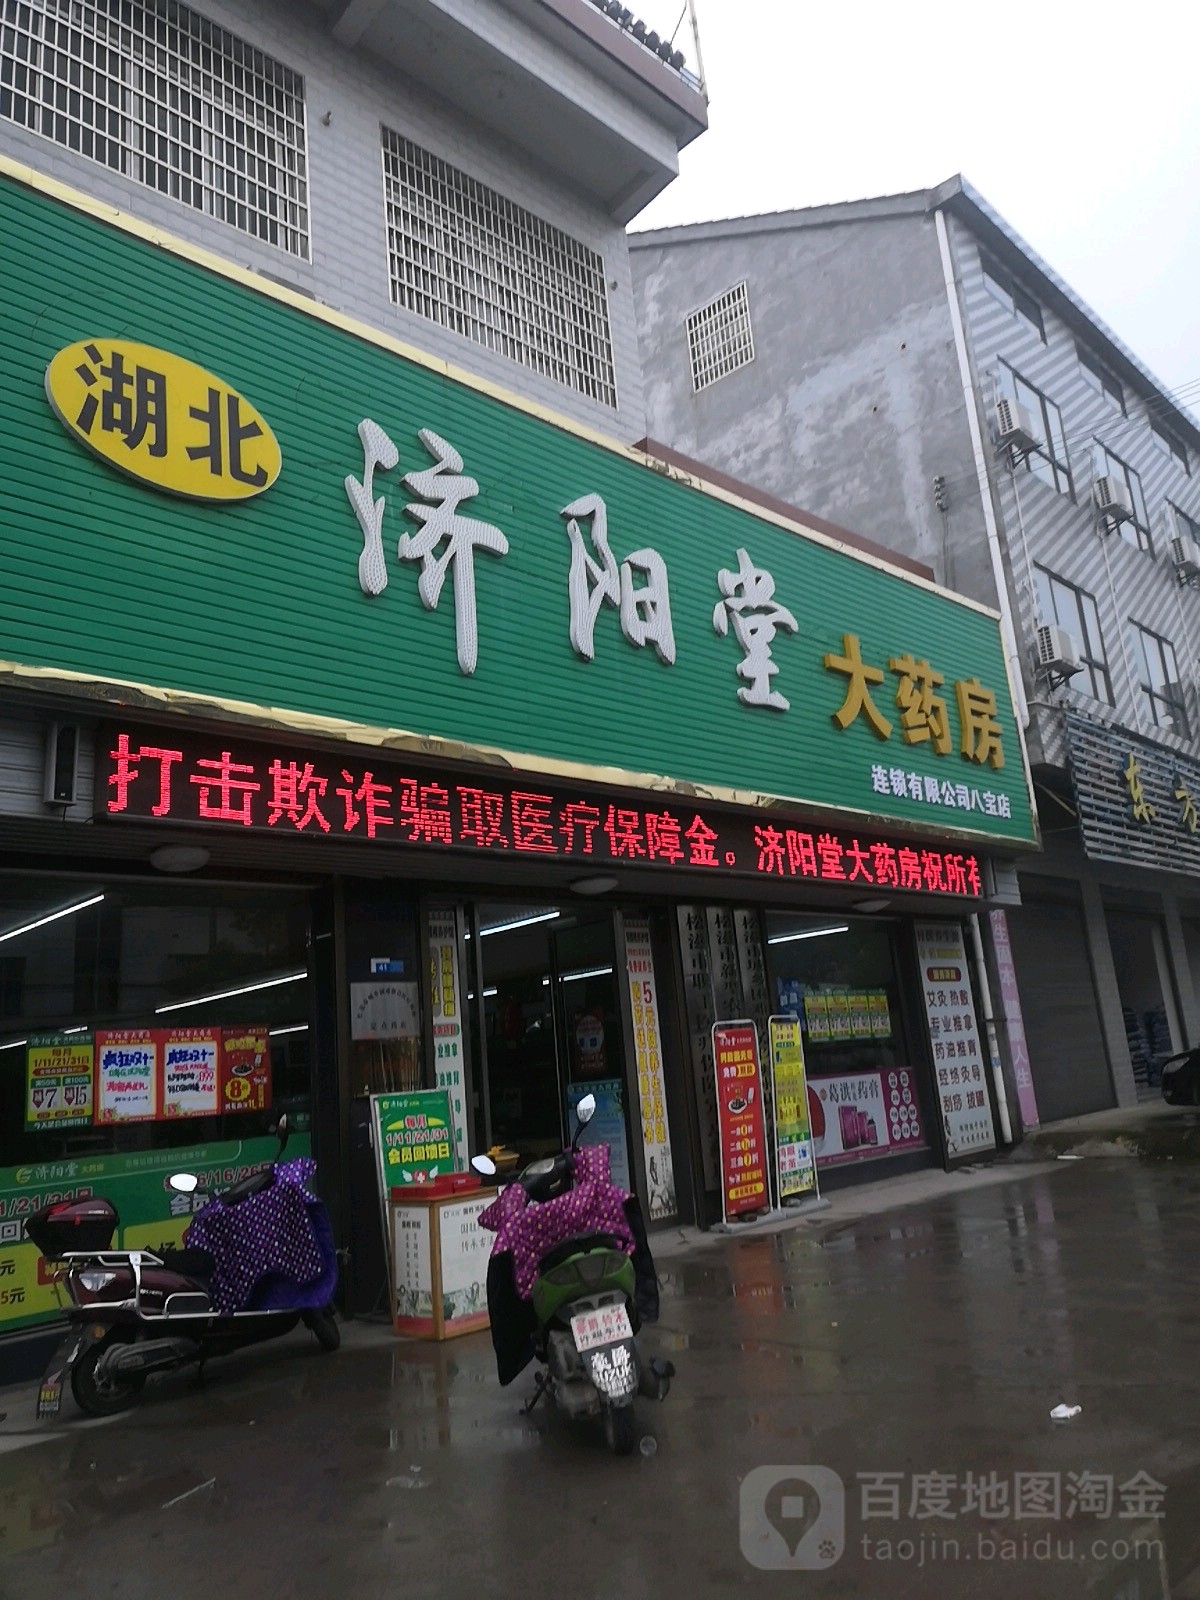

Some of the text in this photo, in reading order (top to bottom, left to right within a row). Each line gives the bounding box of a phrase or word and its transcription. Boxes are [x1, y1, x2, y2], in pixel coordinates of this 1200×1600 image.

[75, 343, 269, 487] 湖北
[345, 418, 1005, 769] 济阳堂 大药房
[871, 764, 1012, 819] 连锁有限公司八宝店
[405, 1114, 427, 1129] 每月
[386, 1127, 449, 1146] 1/11/21/31
[388, 1142, 450, 1165] 会员回馈日
[35, 1161, 79, 1180] 济阳堂
